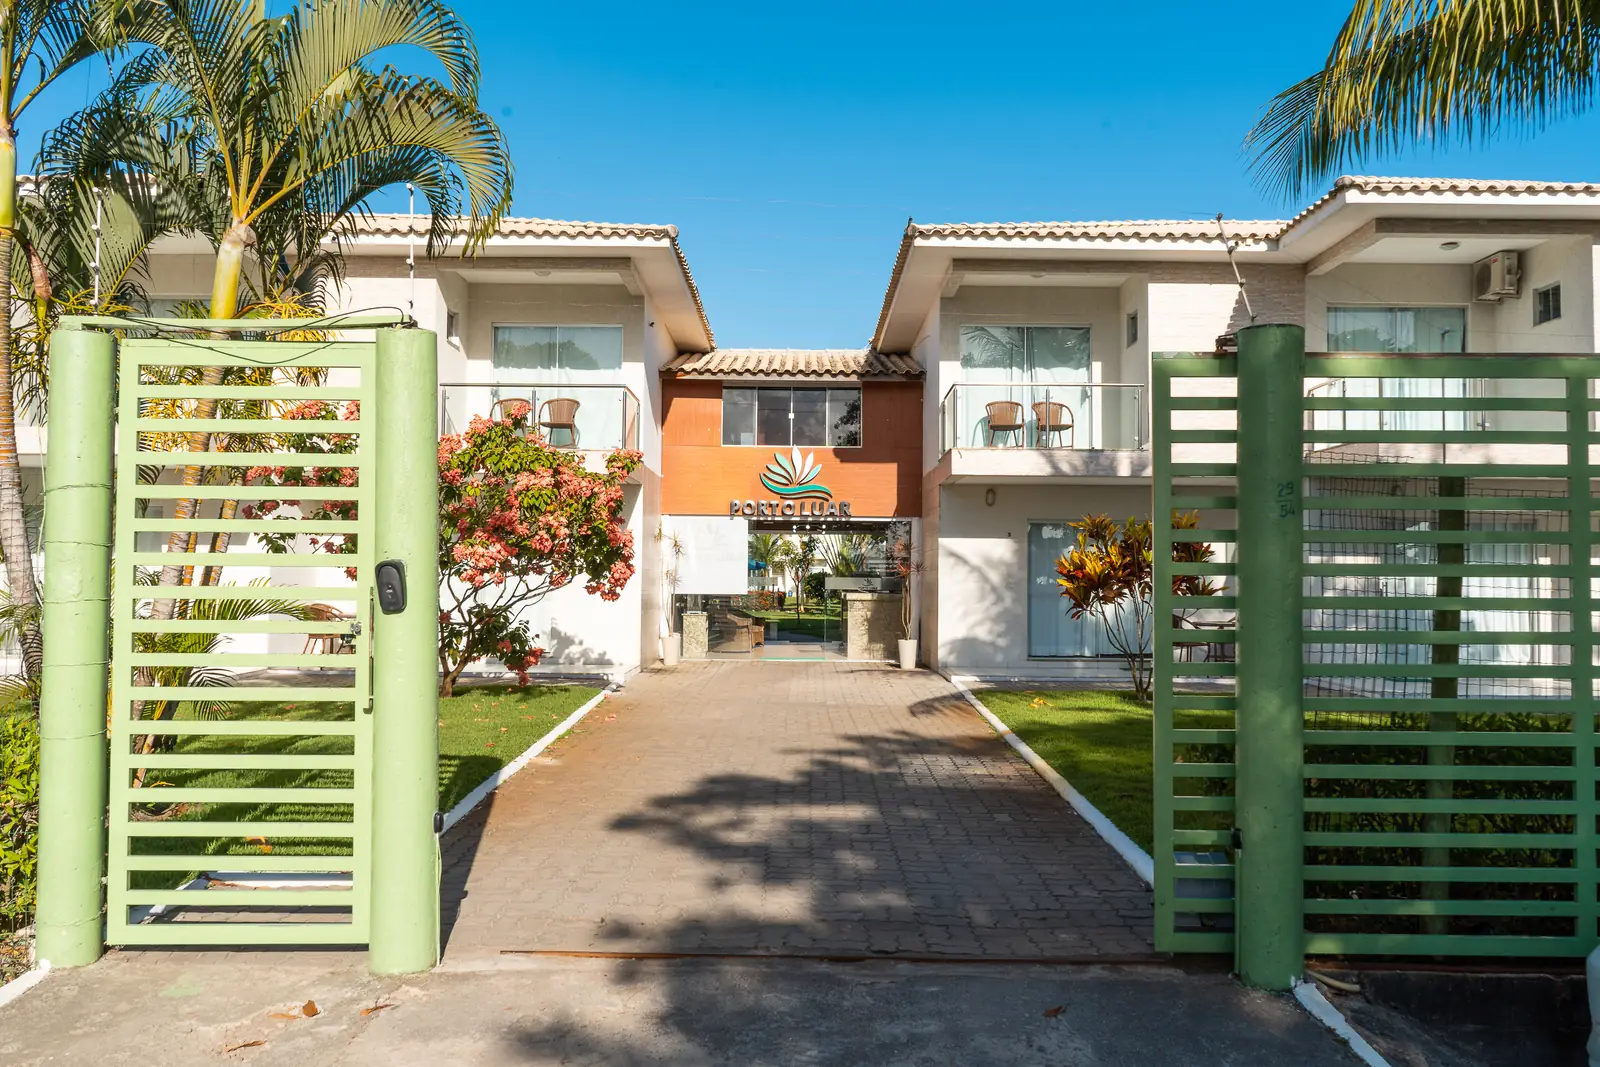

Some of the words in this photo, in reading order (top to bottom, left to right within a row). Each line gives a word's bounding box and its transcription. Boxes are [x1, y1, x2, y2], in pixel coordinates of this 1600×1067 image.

[1277, 481, 1294, 498] 29
[730, 499, 796, 516] PORTO
[799, 501, 852, 516] LUAR
